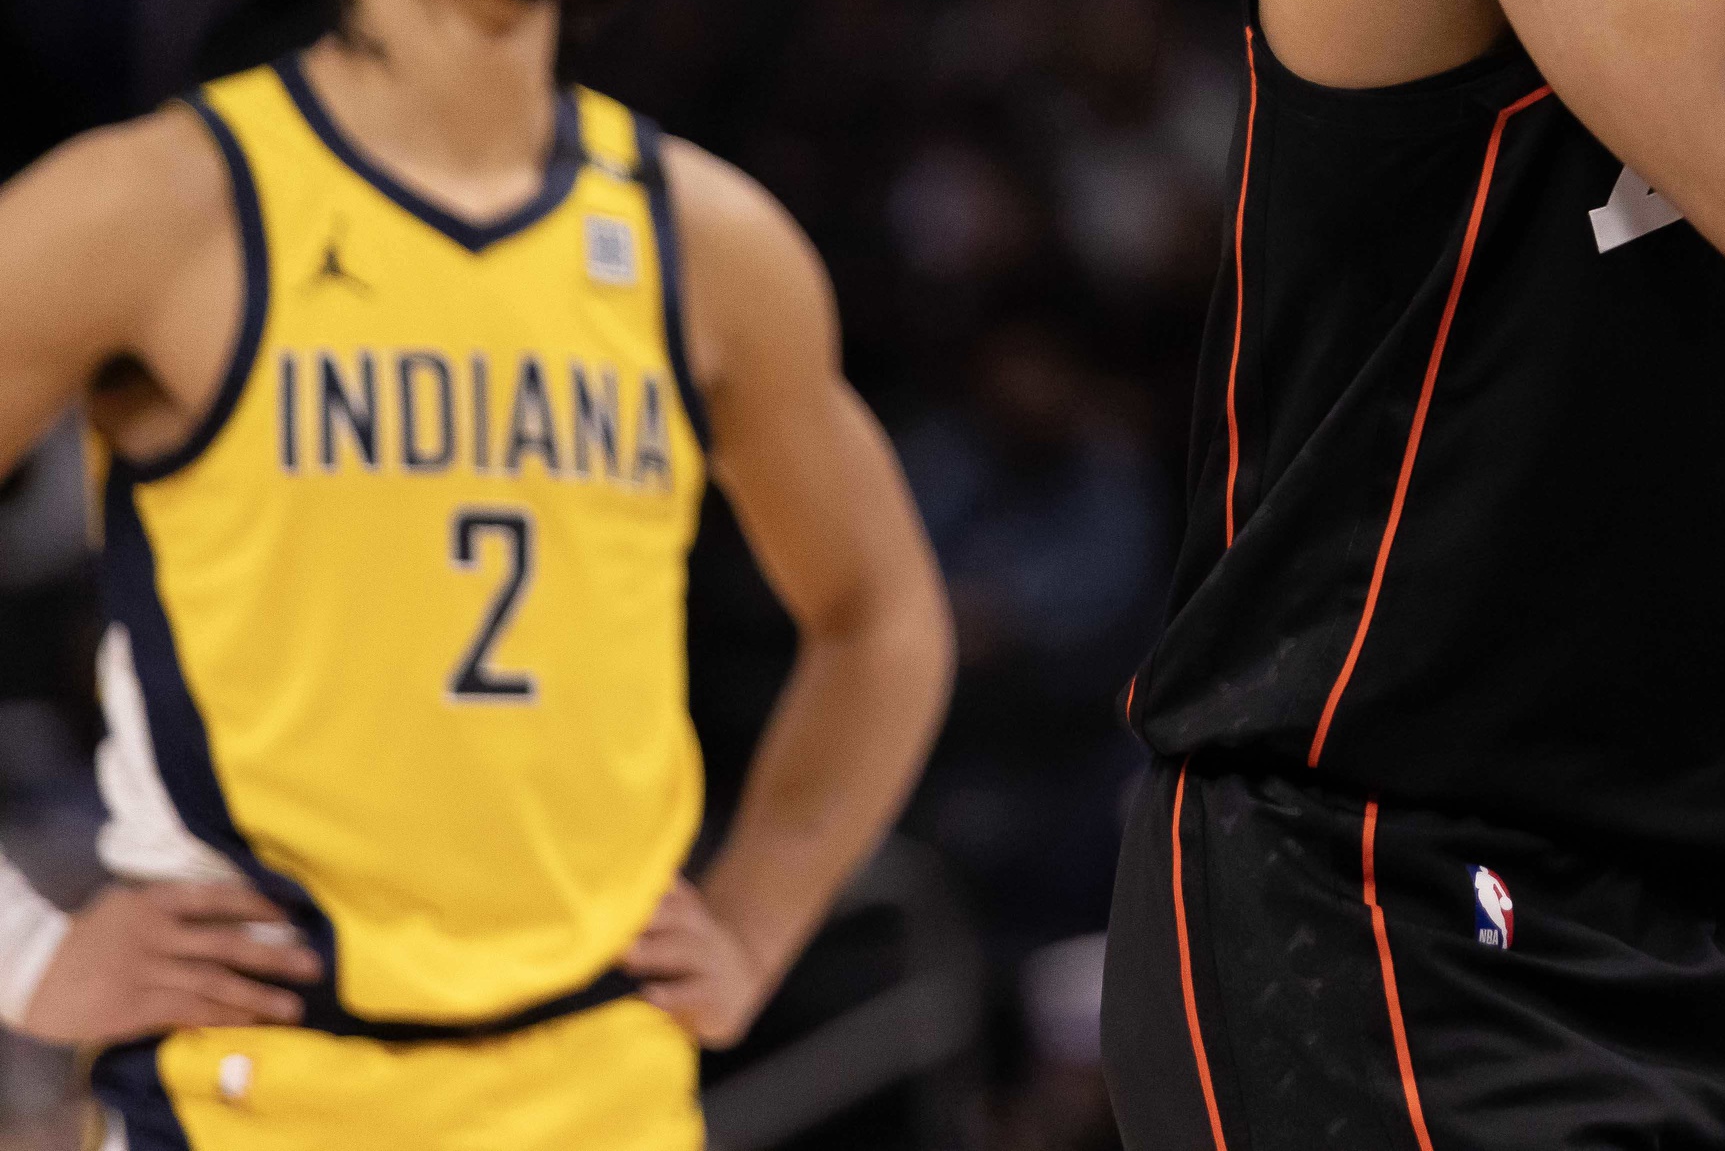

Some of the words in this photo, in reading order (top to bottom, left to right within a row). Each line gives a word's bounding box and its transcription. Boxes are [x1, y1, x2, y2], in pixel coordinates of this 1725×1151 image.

[276, 346, 675, 493] INDIANA
[447, 502, 538, 706] 2
[1479, 928, 1499, 946] NBA
